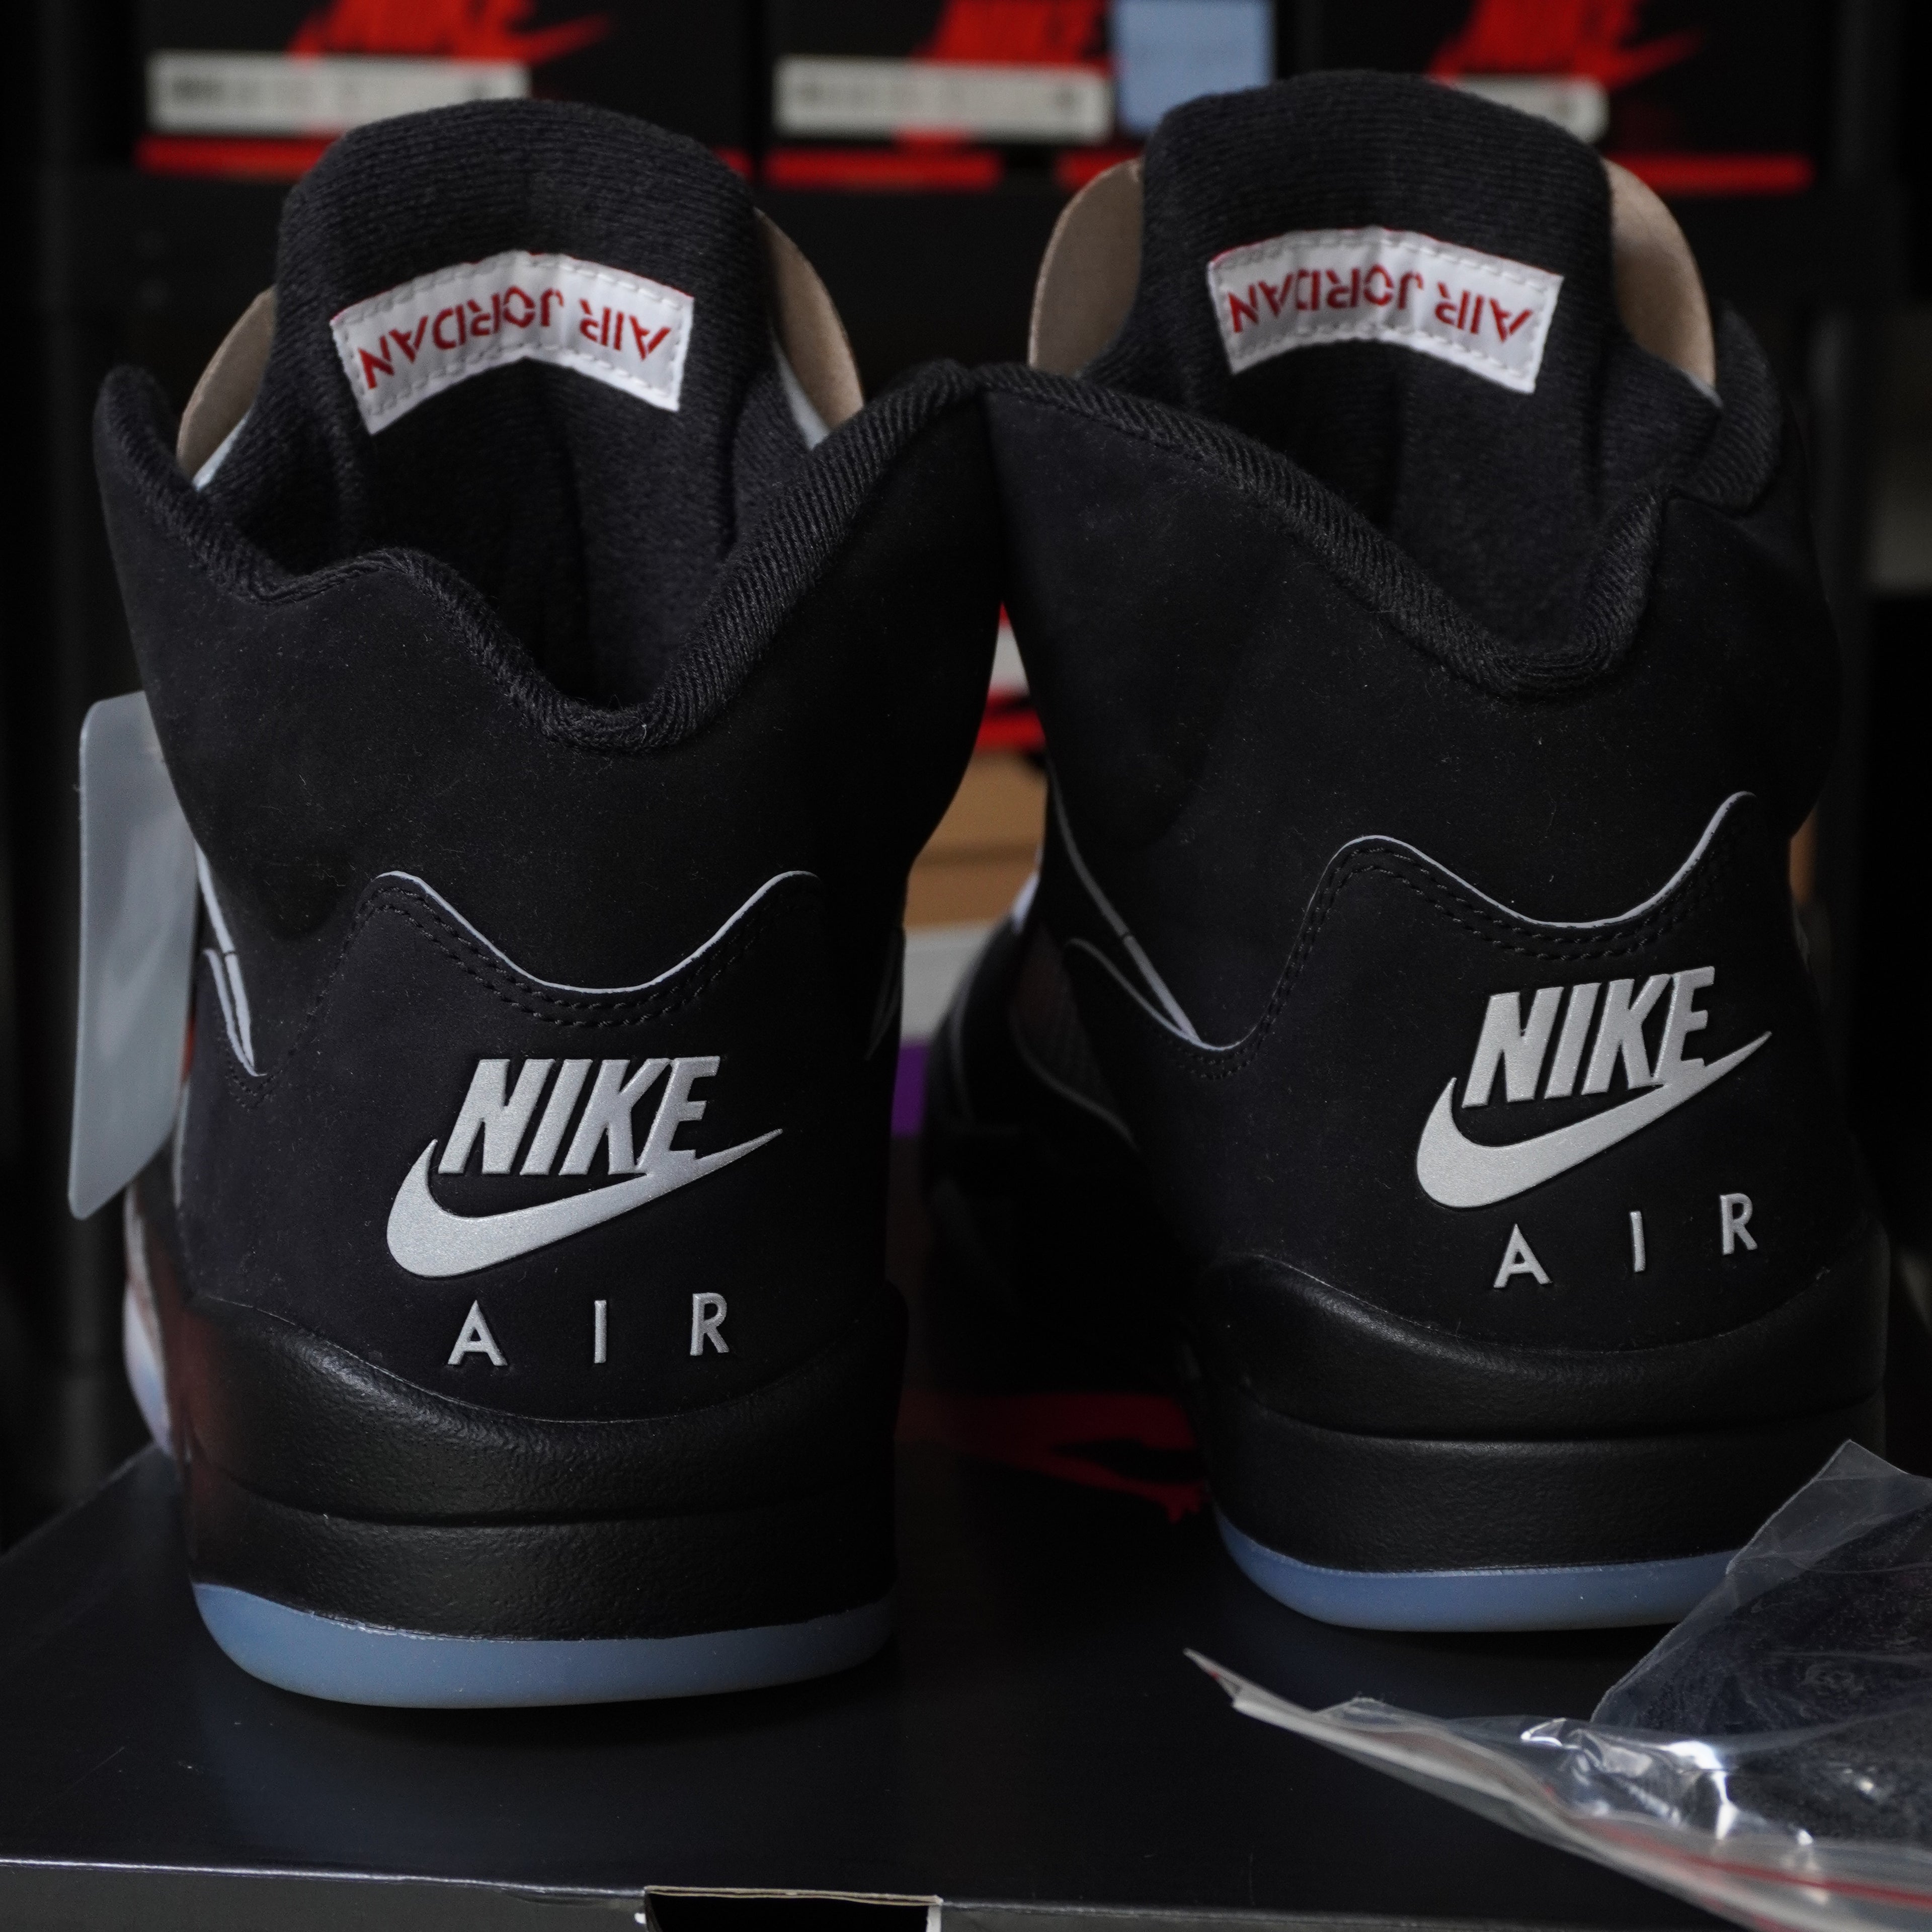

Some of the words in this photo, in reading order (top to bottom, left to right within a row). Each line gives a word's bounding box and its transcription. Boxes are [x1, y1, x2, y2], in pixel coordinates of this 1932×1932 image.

[358, 285, 564, 390] JORDAN
[579, 298, 671, 361] AIR
[1228, 264, 1424, 334] JORDAN
[1433, 282, 1533, 342] AIR
[1462, 966, 1715, 1108] NIKE
[438, 1056, 720, 1176] NIKE
[1493, 1192, 1758, 1289] AIR
[447, 1292, 730, 1366] AIR
